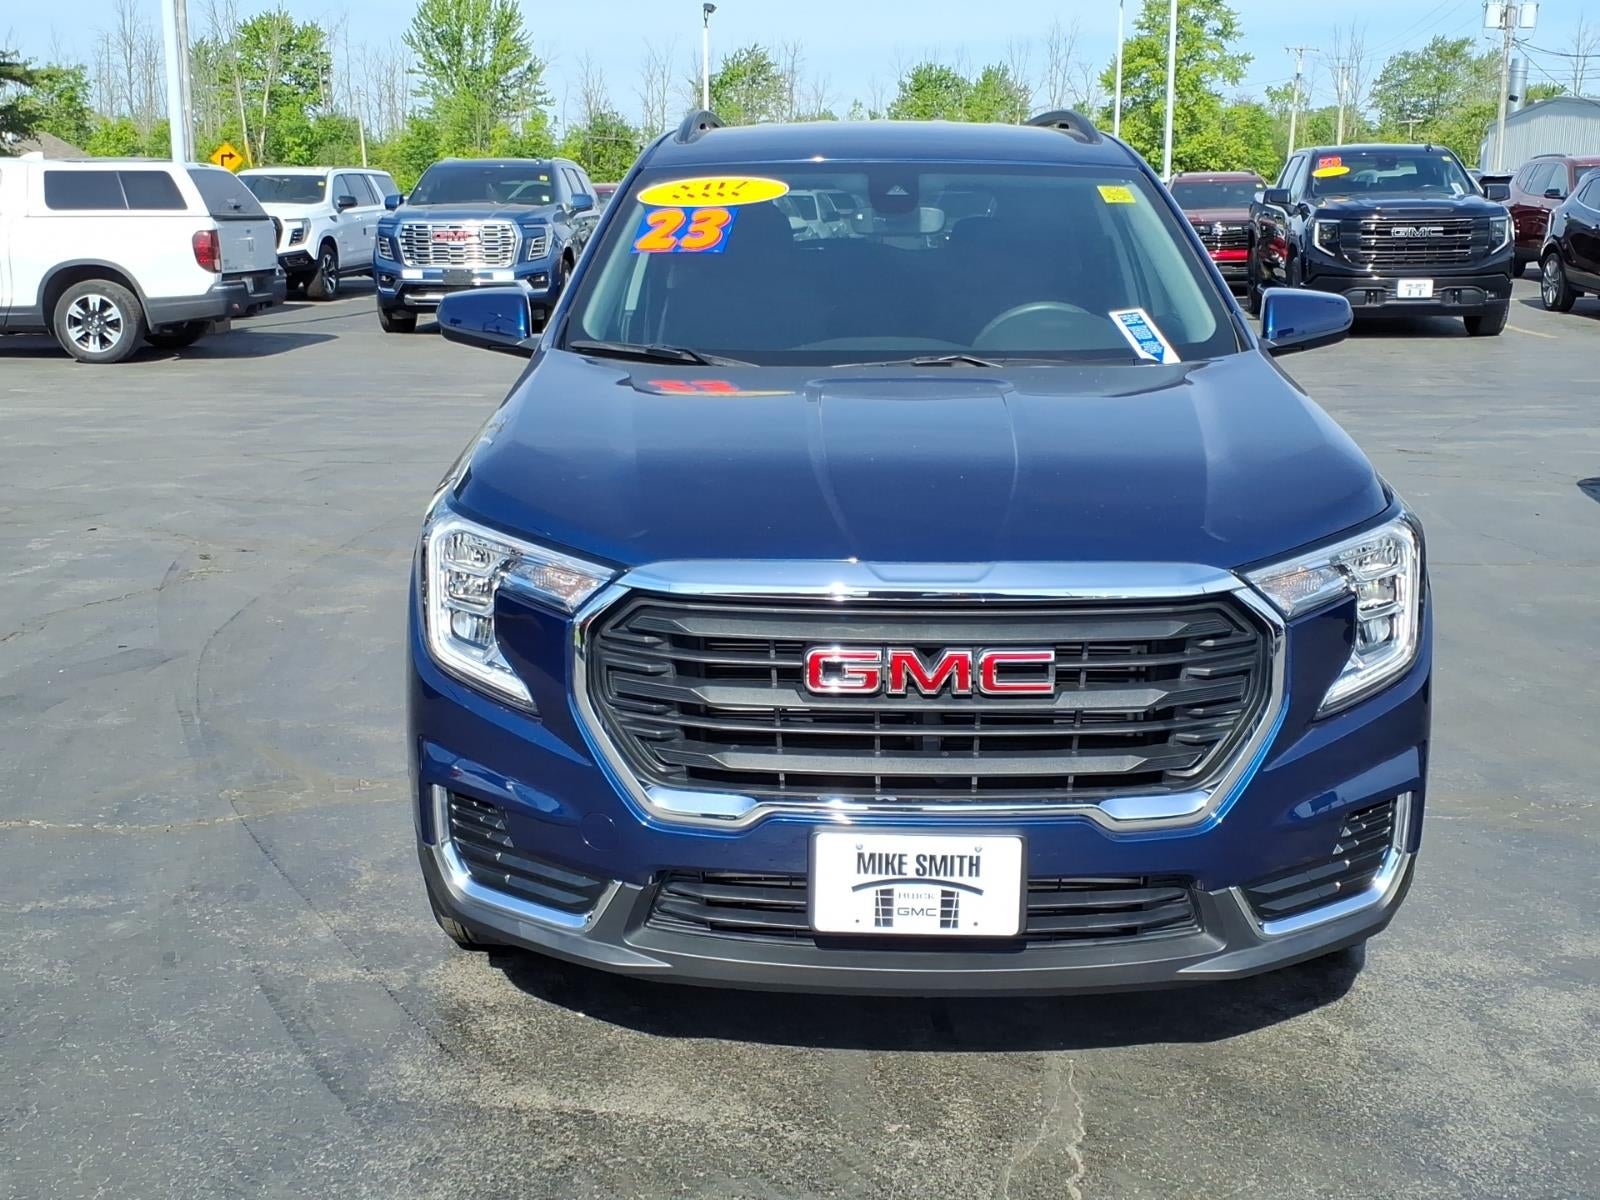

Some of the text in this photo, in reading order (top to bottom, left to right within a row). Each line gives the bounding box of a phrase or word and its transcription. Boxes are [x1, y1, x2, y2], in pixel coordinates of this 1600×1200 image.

[634, 207, 732, 252] 23
[1391, 226, 1444, 238] GMC
[803, 646, 1056, 695] GMC
[856, 852, 981, 877] MIKE SMITH
[897, 907, 937, 917] GMC
